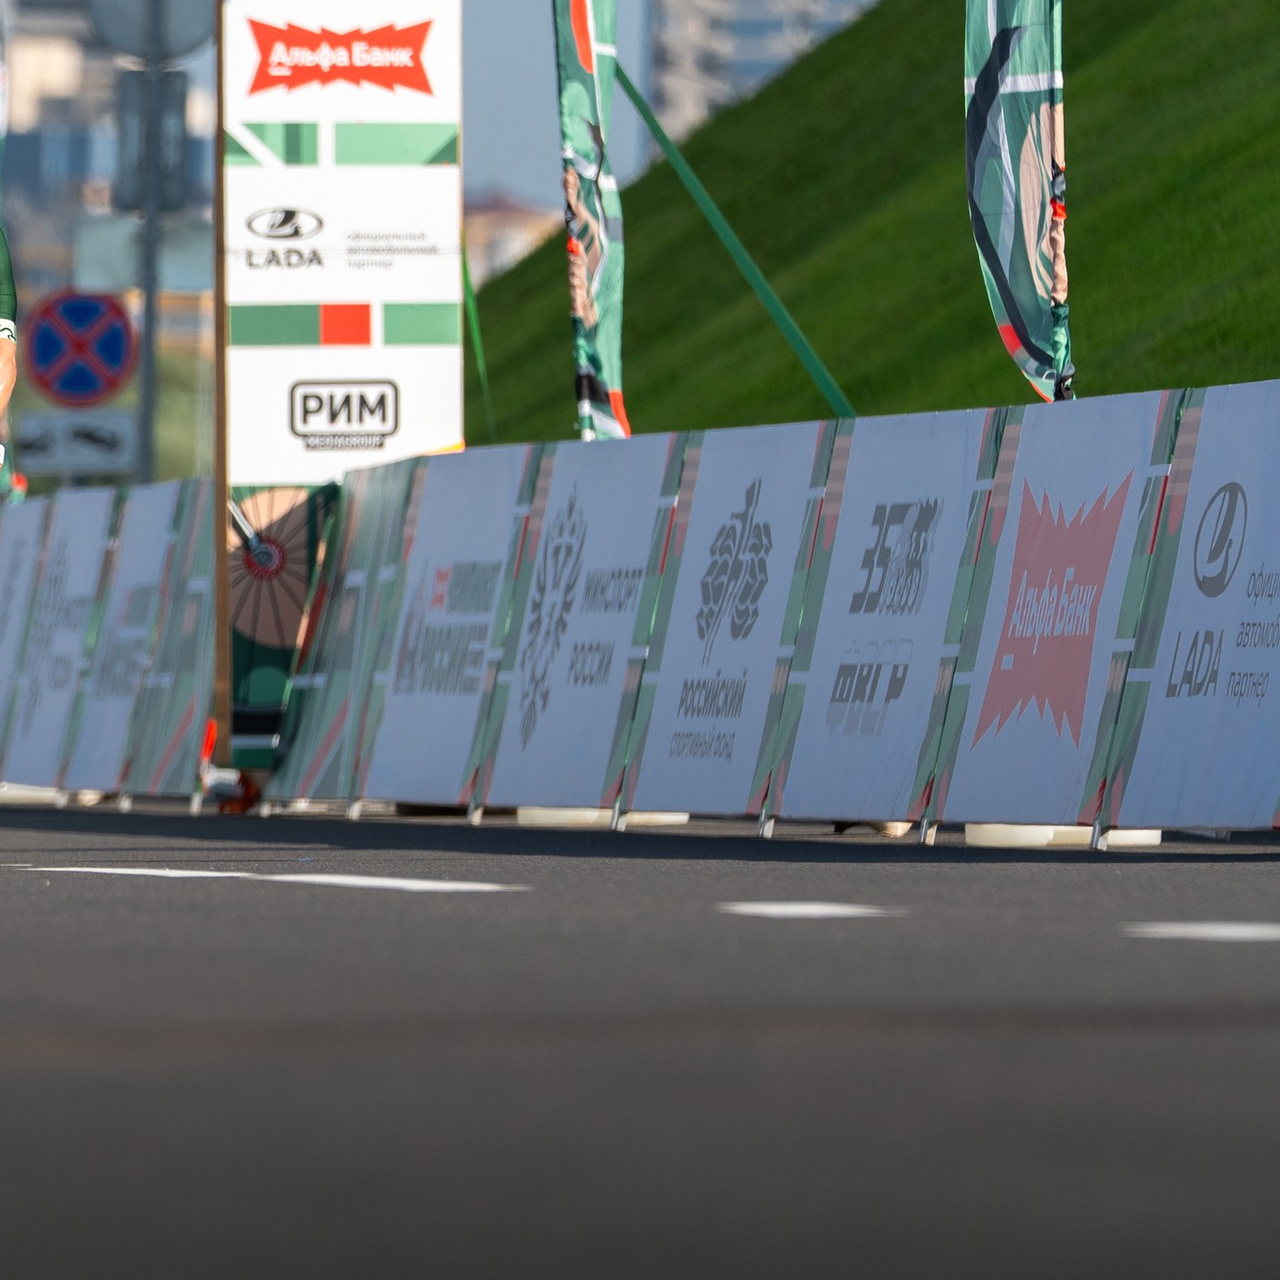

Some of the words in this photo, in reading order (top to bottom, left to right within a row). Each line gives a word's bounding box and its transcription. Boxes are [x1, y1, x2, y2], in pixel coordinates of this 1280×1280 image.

[269, 41, 351, 73] Альфа
[351, 41, 415, 68] Банк
[246, 248, 325, 269] LADA
[302, 394, 386, 424] РИМ
[1007, 568, 1058, 656] Альфа
[1053, 567, 1098, 637] Банк
[1236, 613, 1280, 649] автомоб
[567, 641, 615, 687] РОССИИ
[1166, 630, 1225, 698] LADA
[677, 668, 748, 718] РОССИЙСКИЙ
[1226, 672, 1270, 707] партнер
